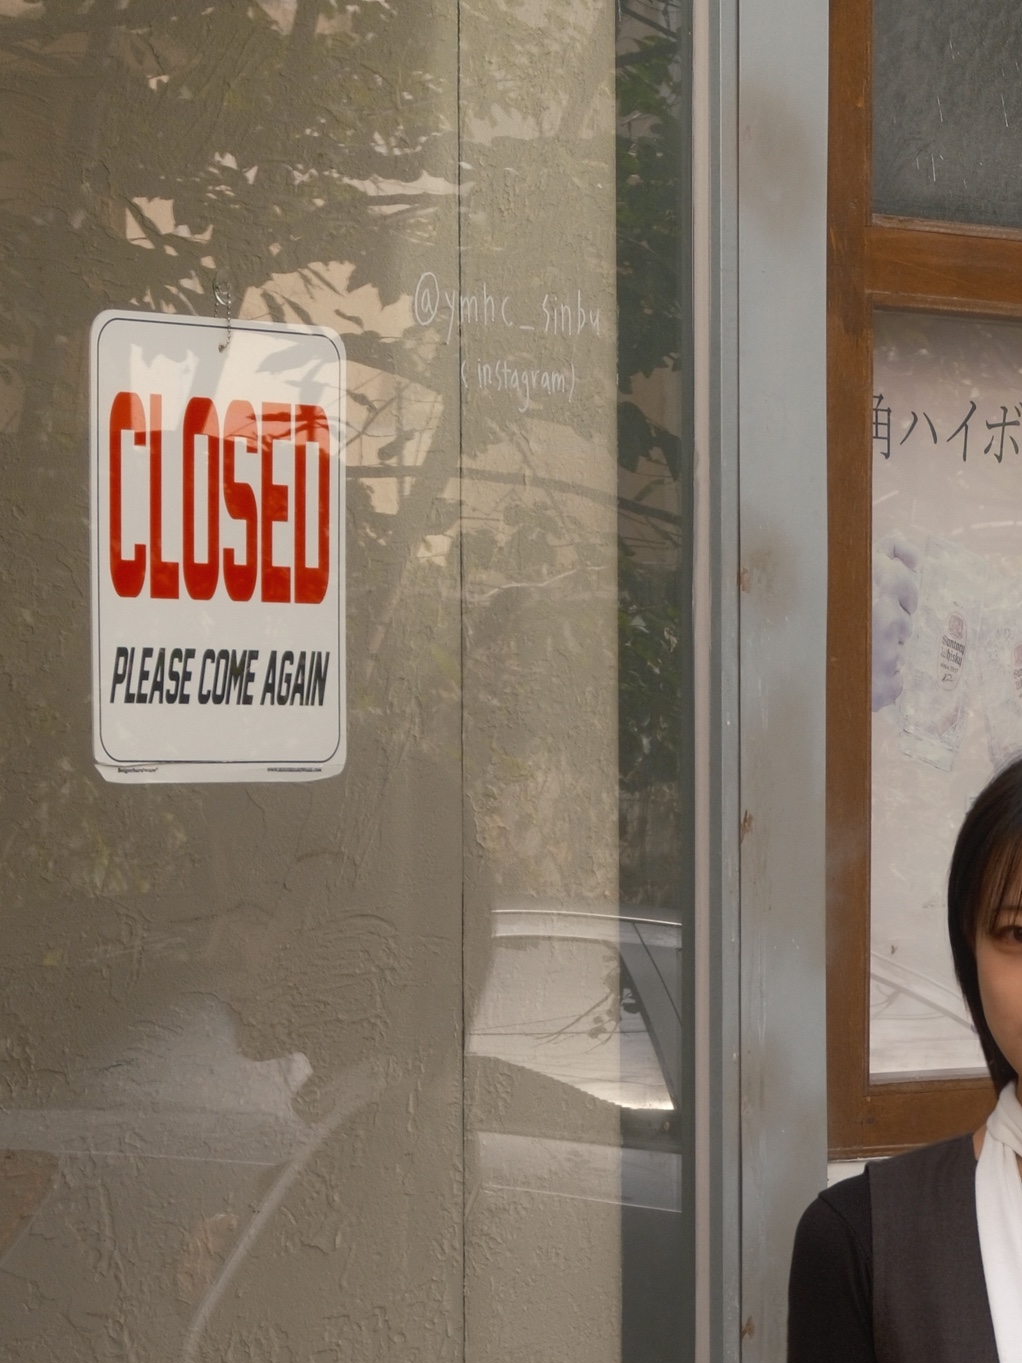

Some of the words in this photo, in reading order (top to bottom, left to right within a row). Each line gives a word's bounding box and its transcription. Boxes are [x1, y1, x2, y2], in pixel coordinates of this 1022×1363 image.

[109, 391, 331, 604] CLOSED
[110, 647, 196, 704] PLEASE
[197, 649, 259, 705] COME
[260, 650, 330, 706] AGAIN
